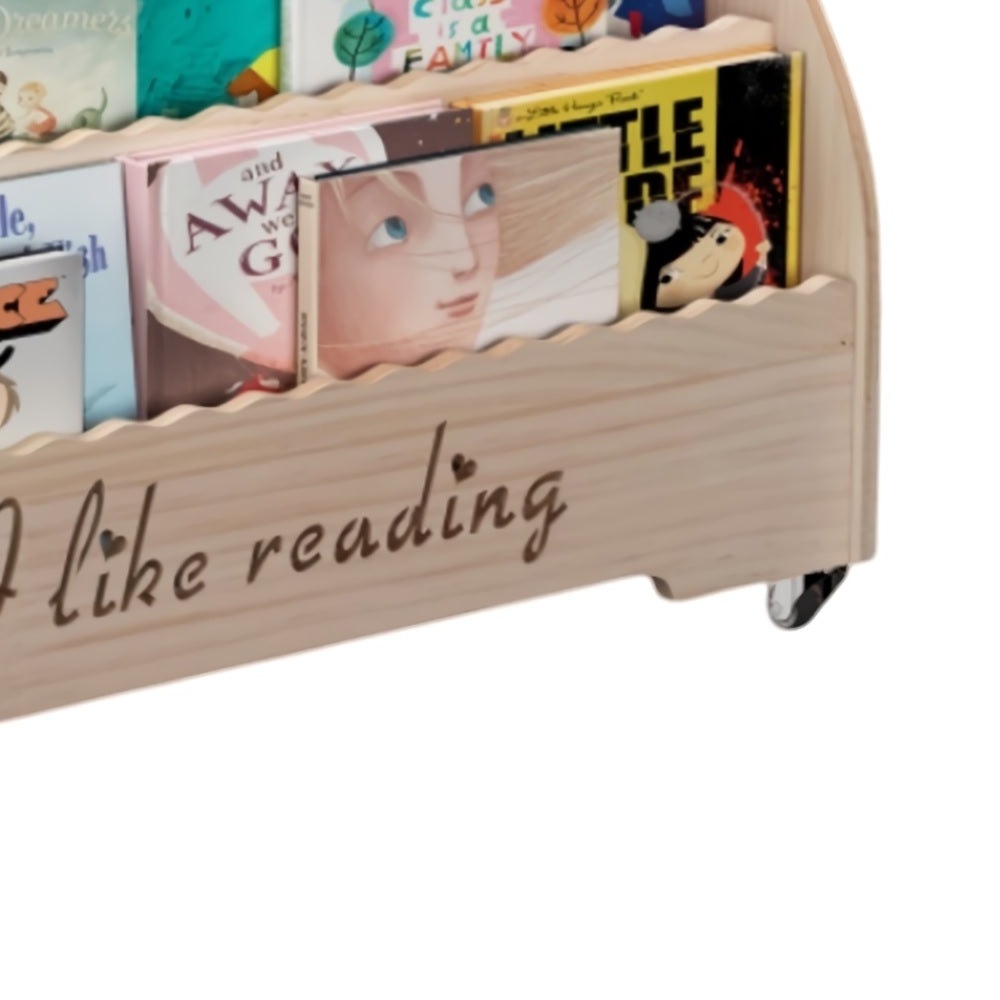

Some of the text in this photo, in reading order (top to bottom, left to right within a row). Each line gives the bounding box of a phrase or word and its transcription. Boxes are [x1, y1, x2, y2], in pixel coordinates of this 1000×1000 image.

[470, 14, 490, 35] a
[240, 150, 284, 182] and
[46, 478, 210, 627] like
[245, 420, 566, 585] reading
